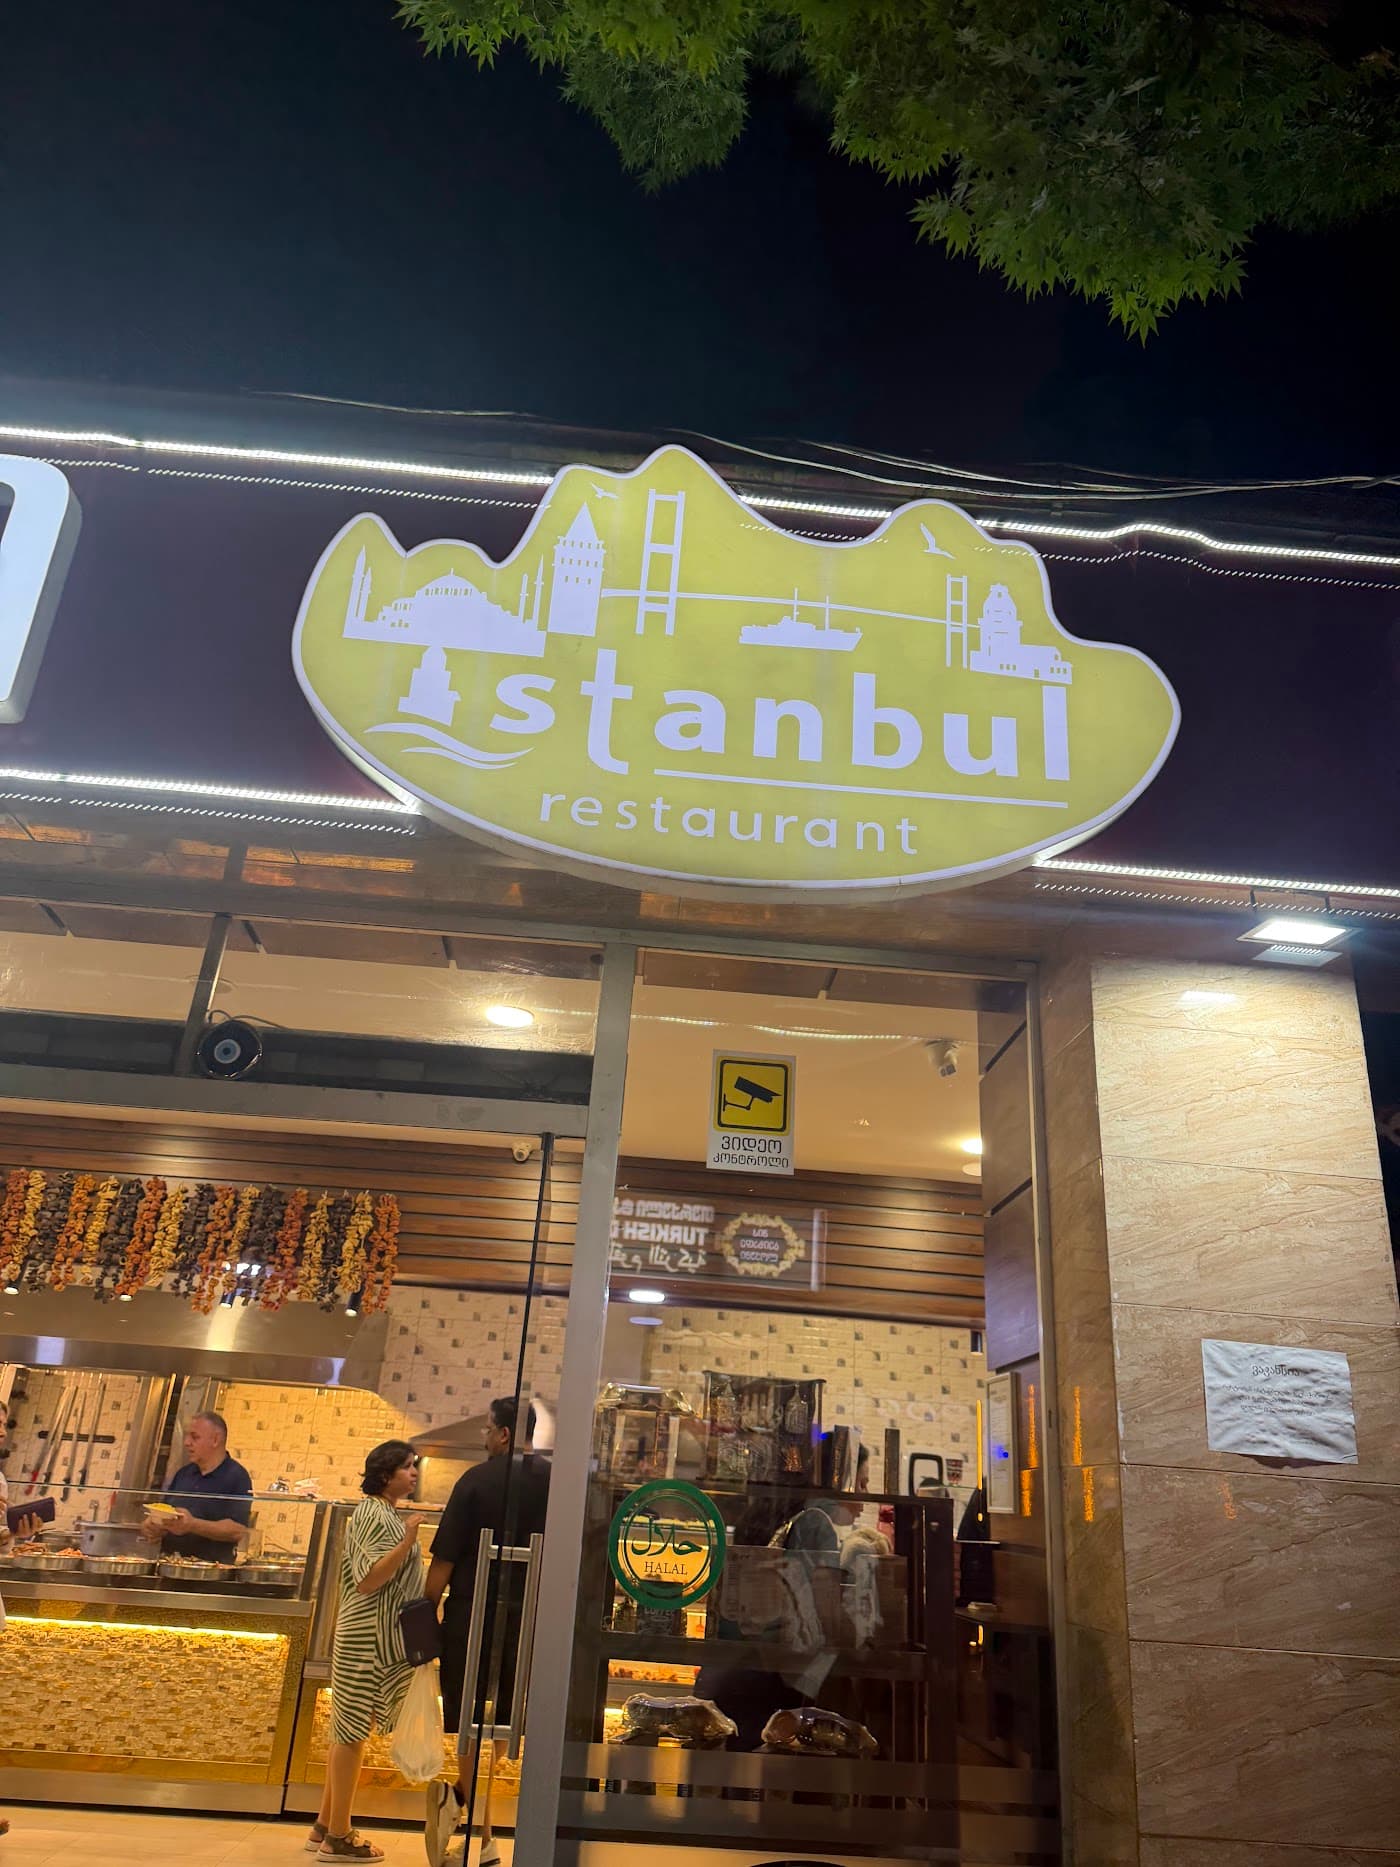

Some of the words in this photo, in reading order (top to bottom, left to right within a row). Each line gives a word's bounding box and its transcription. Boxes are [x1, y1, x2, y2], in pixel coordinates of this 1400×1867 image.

[540, 788, 918, 855] restaurant
[721, 1136, 782, 1153] ვიდეო
[713, 1152, 788, 1168] კონტროლი
[631, 1517, 703, 1556] حلال
[644, 1561, 688, 1576] HALAL
